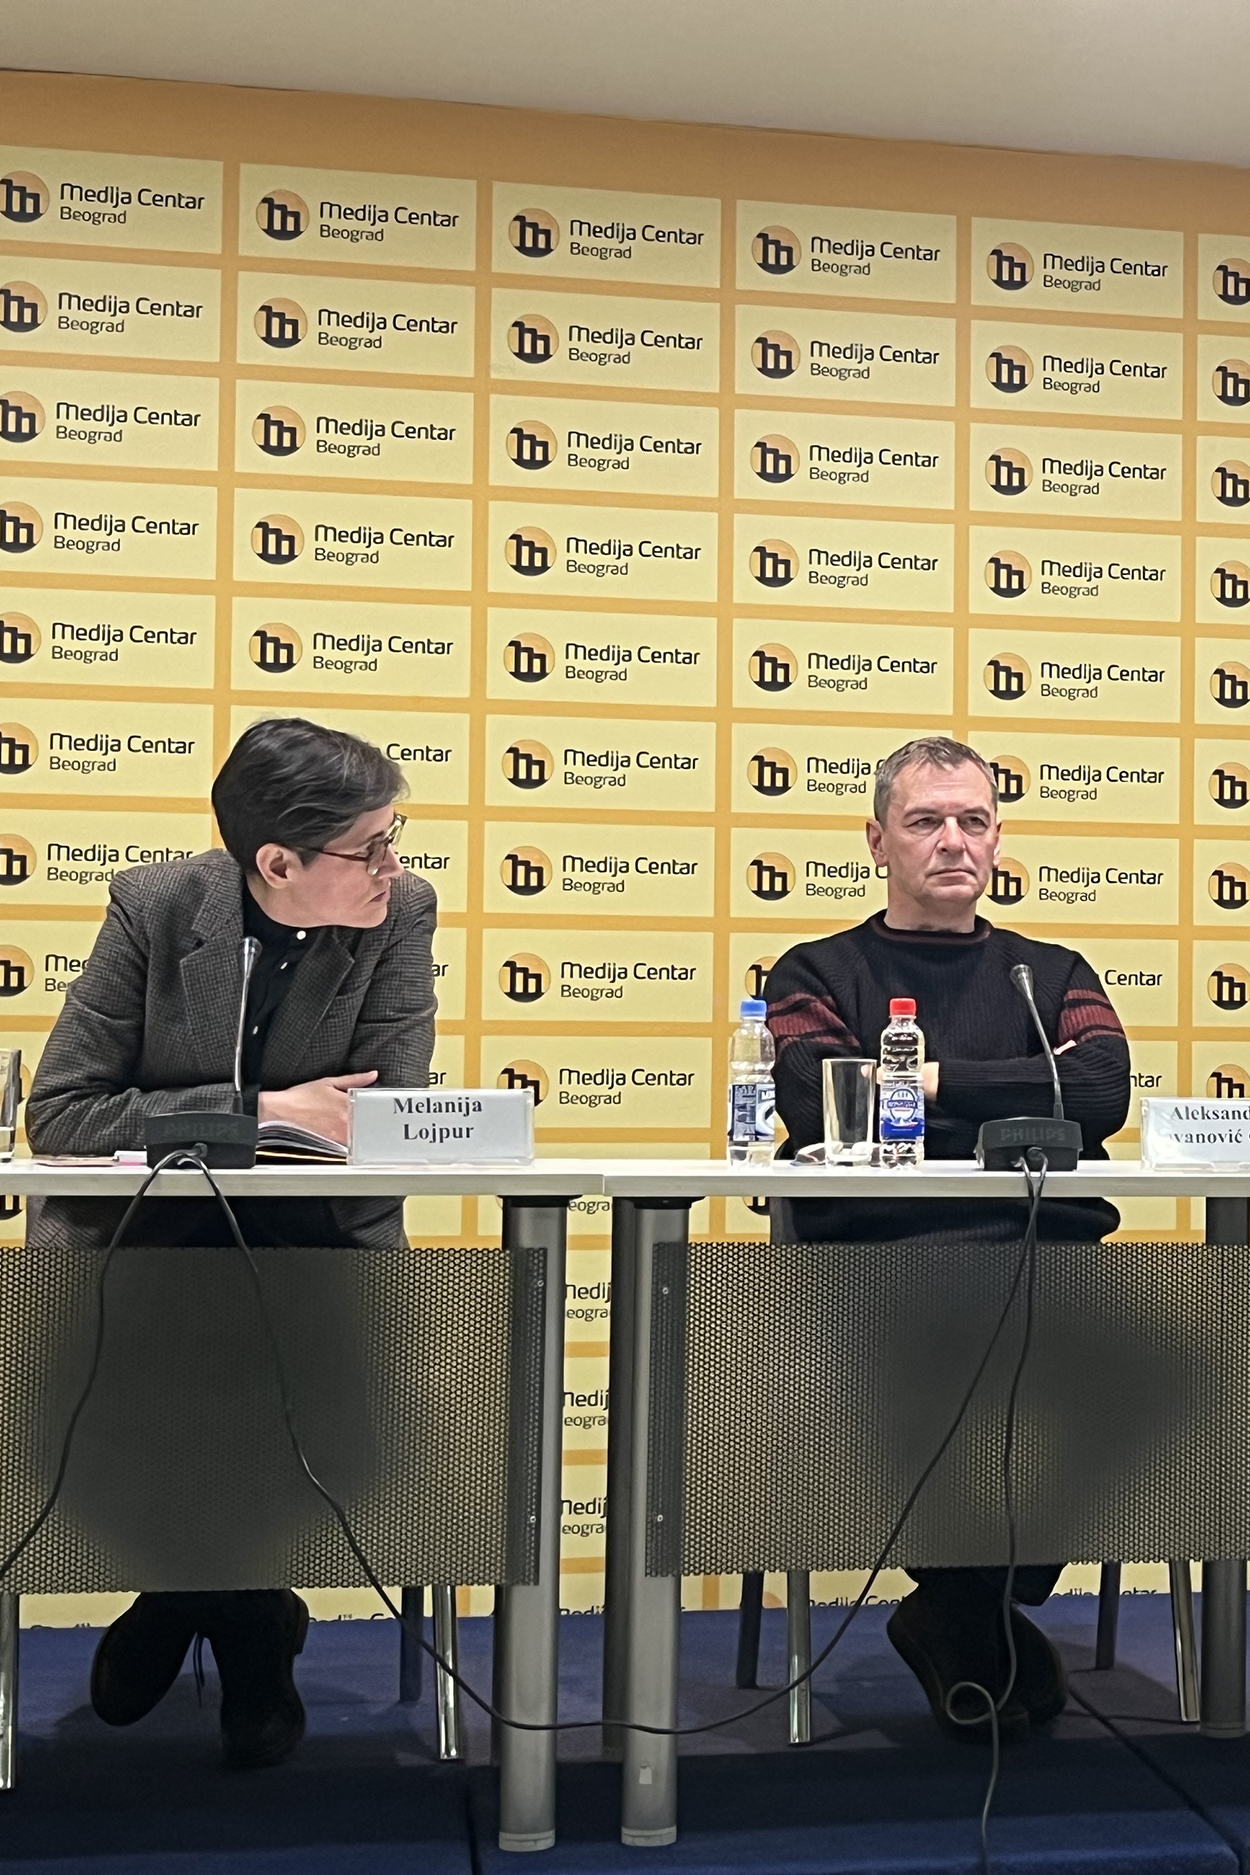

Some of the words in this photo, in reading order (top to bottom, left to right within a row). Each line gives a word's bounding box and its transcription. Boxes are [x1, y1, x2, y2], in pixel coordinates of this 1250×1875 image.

[60, 183, 132, 208] Medija
[138, 188, 205, 209] Centar
[60, 206, 126, 225] Beograd
[320, 202, 388, 226] Medija
[394, 207, 459, 227] Centar
[320, 224, 384, 243] Beograd
[570, 220, 636, 244] Medija
[642, 225, 704, 245] Centar
[570, 242, 631, 260] Beograd
[1044, 253, 1105, 276] Medija
[1110, 258, 1168, 277] Centar
[1043, 275, 1101, 292] Beograd
[57, 402, 127, 426] Medija
[134, 407, 201, 426] Centar
[56, 425, 122, 444] Beograd
[568, 431, 634, 455] Medija
[640, 436, 702, 454] Centar
[568, 454, 629, 471] Beograd
[1043, 458, 1103, 480] Medija
[1109, 461, 1166, 480] Centar
[1042, 479, 1099, 496] Beograd
[313, 633, 382, 656] Medija
[388, 636, 453, 654] Centar
[313, 656, 377, 674] Beograd
[808, 653, 872, 675] Medija
[877, 656, 937, 673] Centar
[808, 675, 867, 692] Beograd
[50, 733, 121, 756] Medija
[128, 735, 195, 754] Centar
[50, 756, 116, 774] Beograd
[564, 749, 630, 771] Medija
[636, 751, 698, 769] Centar
[807, 757, 871, 778] Medija
[564, 772, 625, 789] Beograd
[1040, 764, 1101, 785] Medija
[1107, 766, 1164, 783] Centar
[807, 779, 866, 796] Beograd
[1040, 786, 1097, 802] Beograd
[48, 844, 119, 866] Medija
[563, 855, 629, 877] Medija
[635, 857, 698, 875] Centar
[806, 861, 870, 882] Medija
[563, 878, 624, 895] Beograd
[1039, 866, 1100, 887] Medija
[1106, 868, 1163, 884] Centar
[806, 883, 865, 899] Beograd
[1039, 888, 1096, 904] Beograd
[561, 962, 627, 983] Medija
[634, 963, 696, 980] Centar
[561, 985, 623, 1001] Beograd
[560, 1069, 626, 1090] Medija
[632, 1069, 695, 1086] Centar
[393, 1097, 483, 1117] Melanija
[559, 1091, 621, 1108] Beograd
[403, 1123, 475, 1143] Lojpur
